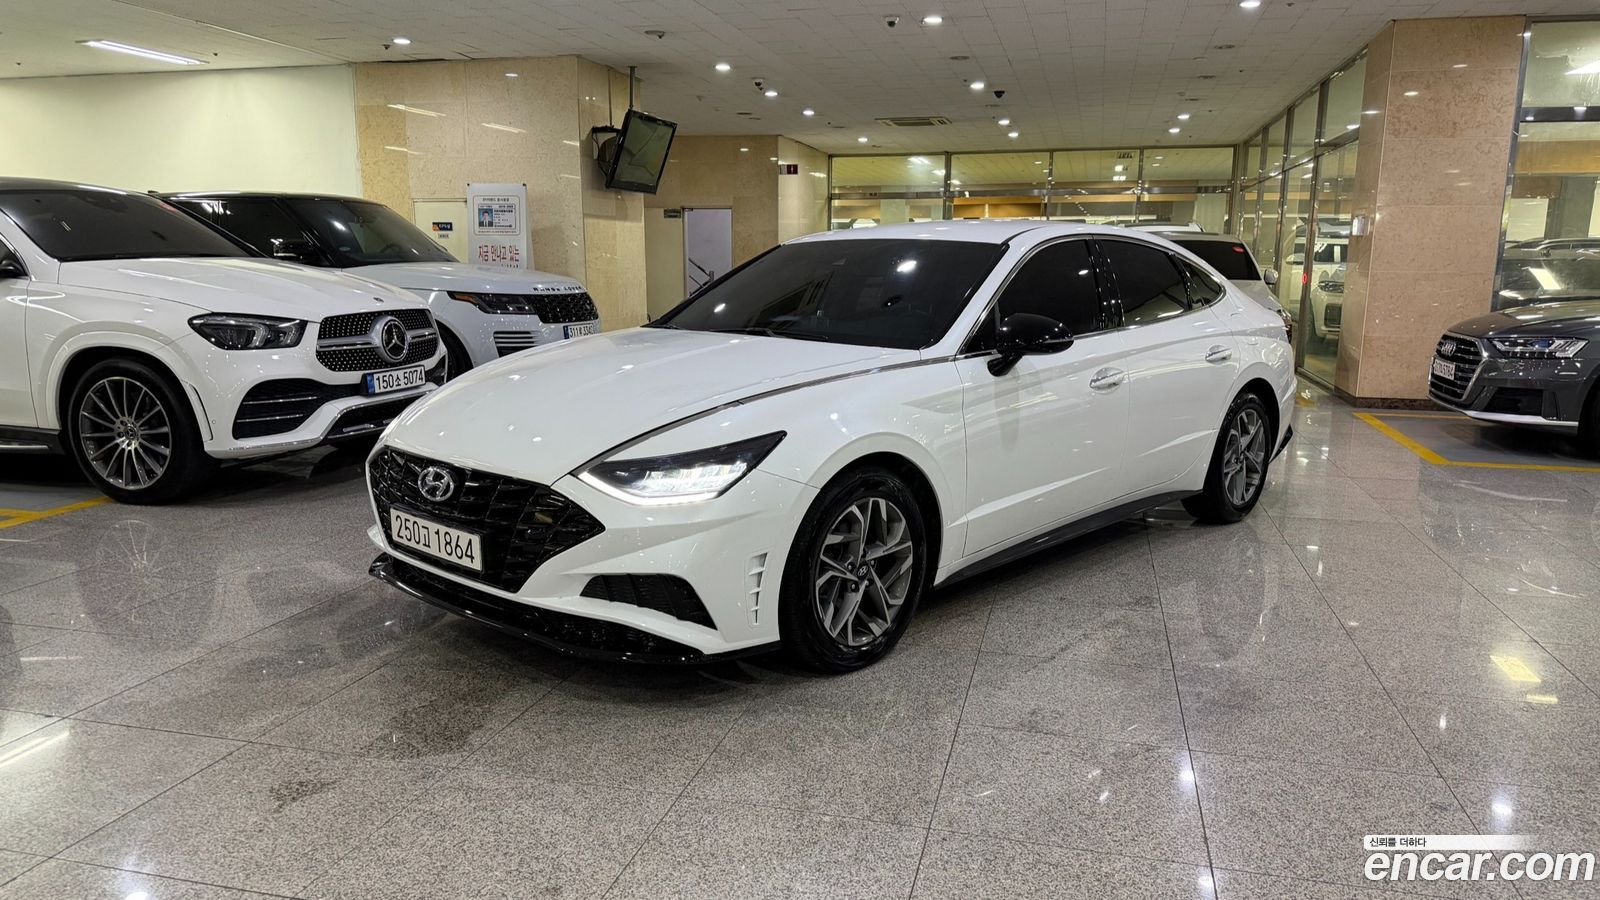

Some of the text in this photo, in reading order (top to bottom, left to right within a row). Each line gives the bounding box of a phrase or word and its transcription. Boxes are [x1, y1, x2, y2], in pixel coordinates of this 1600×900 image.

[478, 244, 520, 262] 지금 만나고 있는
[376, 368, 424, 390] 150소 5074
[395, 514, 475, 564] 250고 1864
